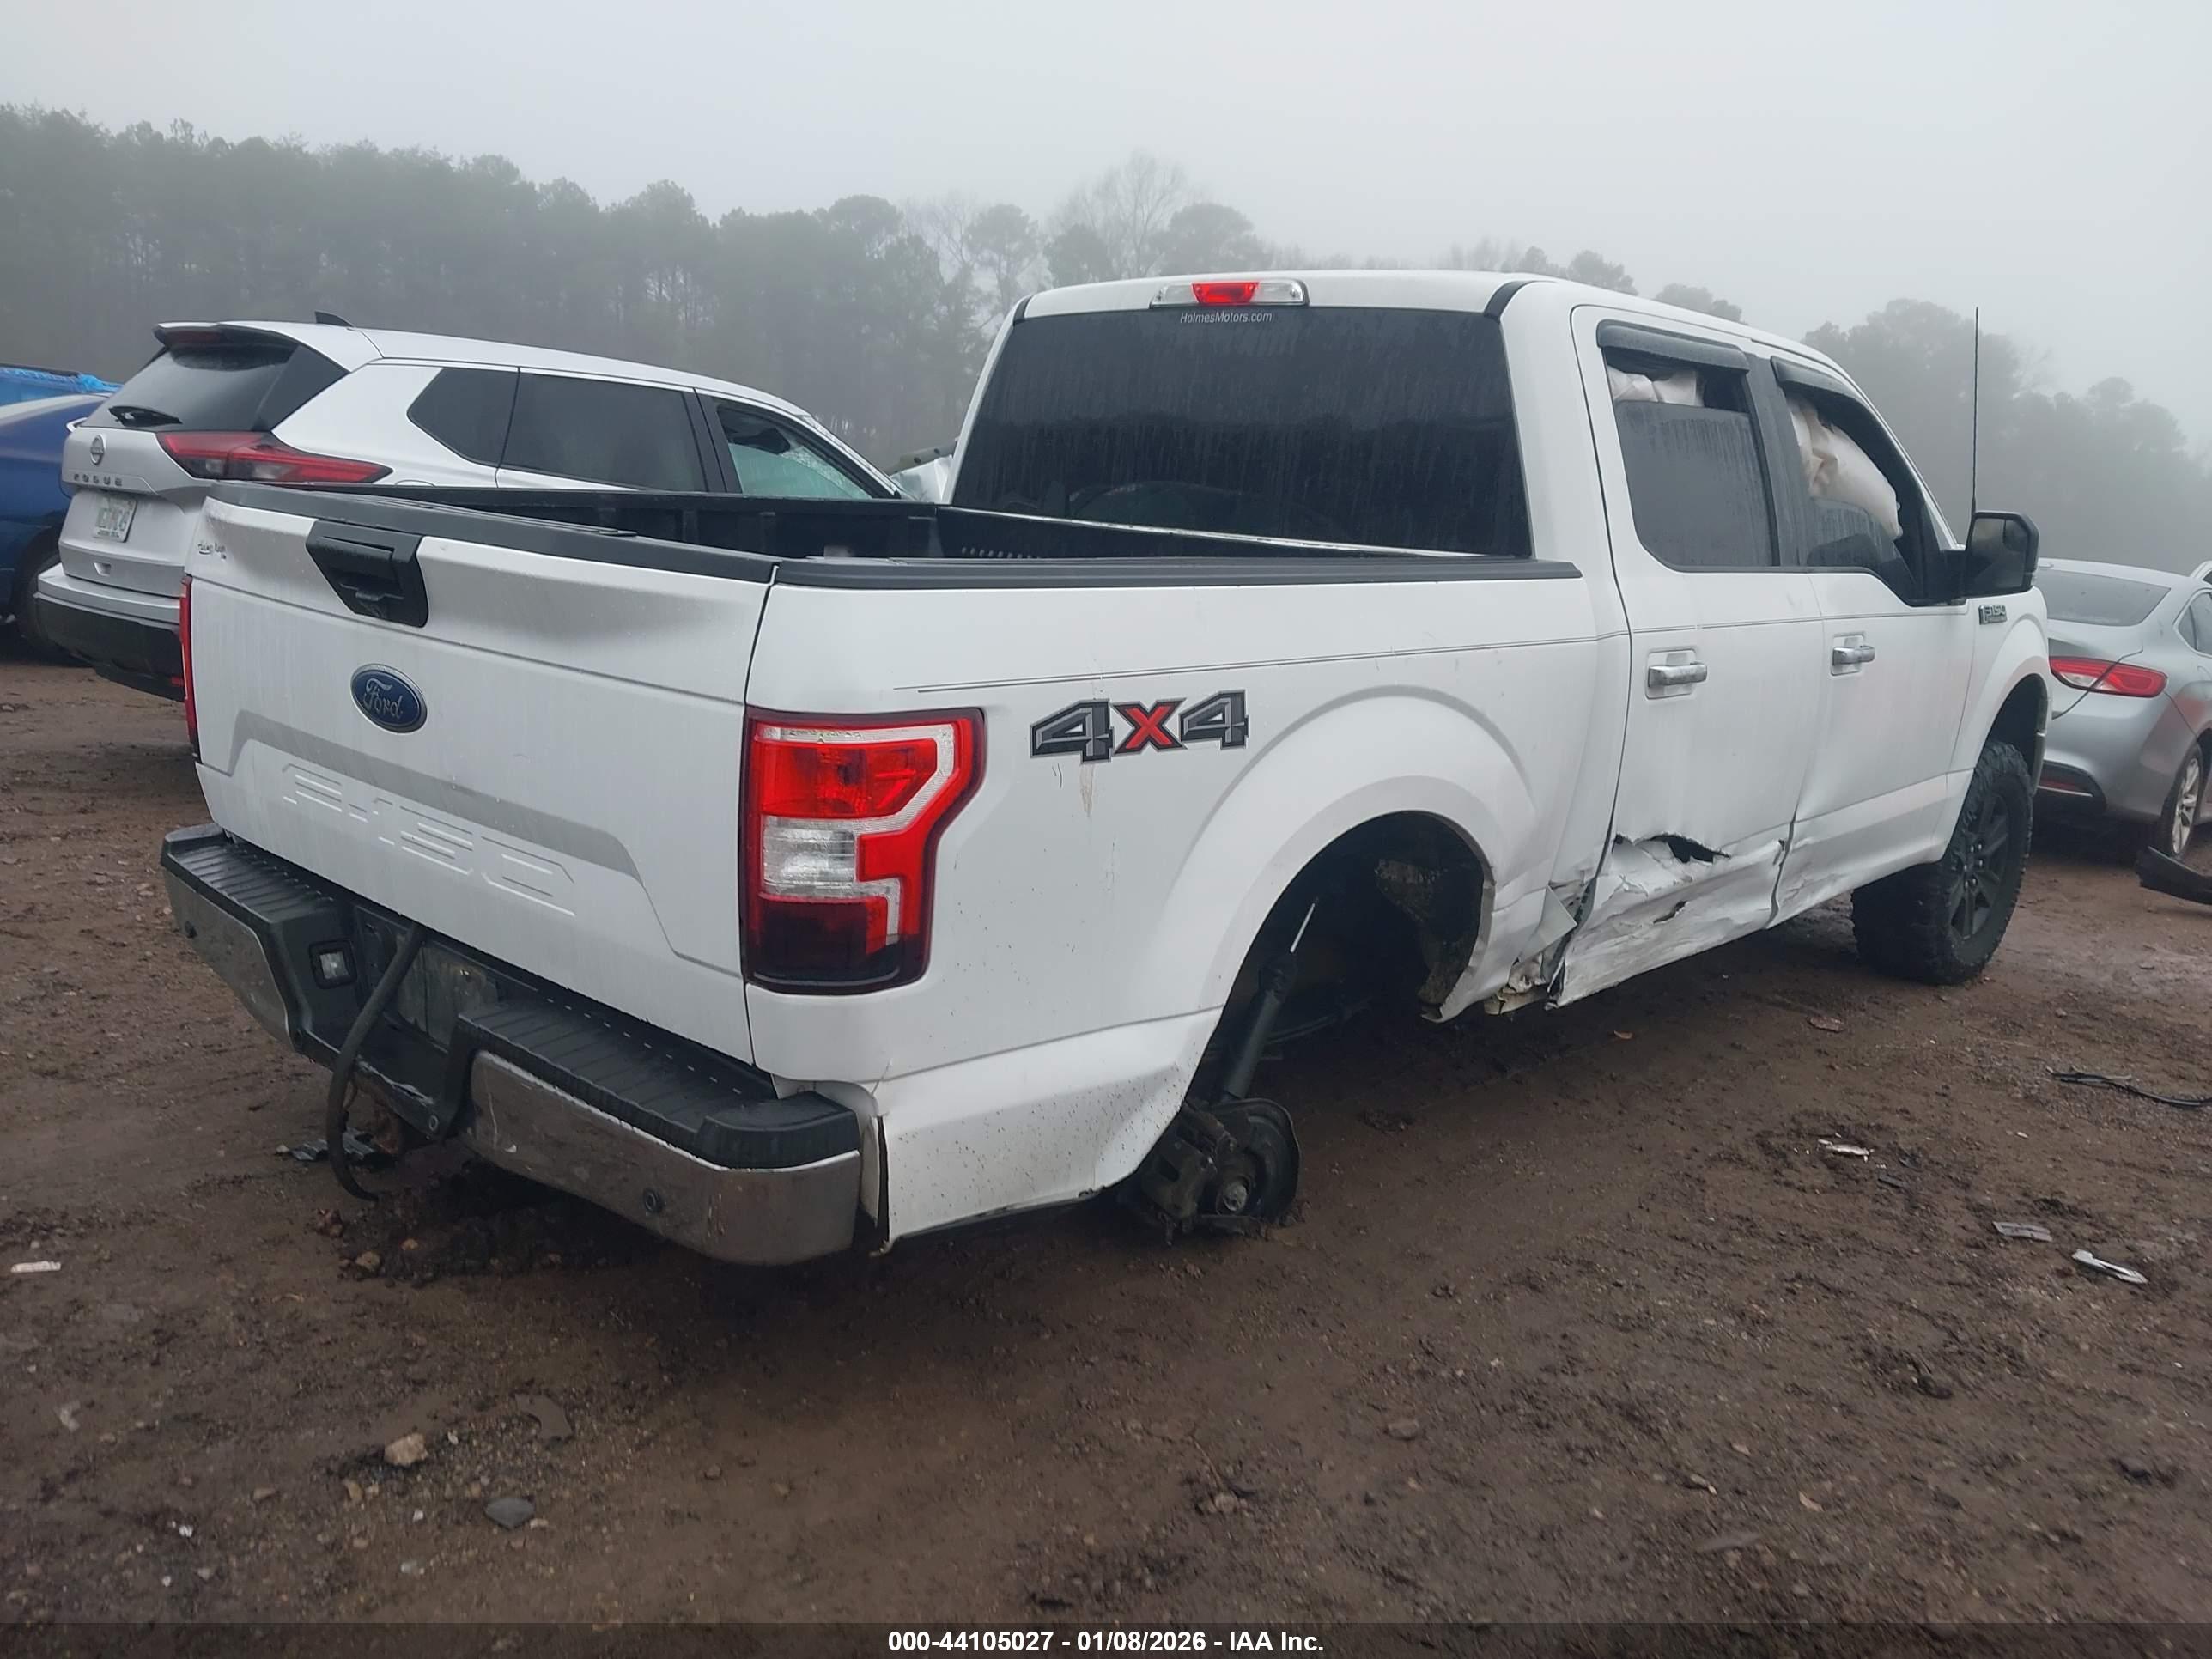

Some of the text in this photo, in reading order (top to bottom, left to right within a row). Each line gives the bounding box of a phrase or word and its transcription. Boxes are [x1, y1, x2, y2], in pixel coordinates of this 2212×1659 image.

[1180, 310, 1273, 324] HolmesMotors.com
[73, 472, 123, 488] ROGUE
[363, 677, 404, 719] Ford
